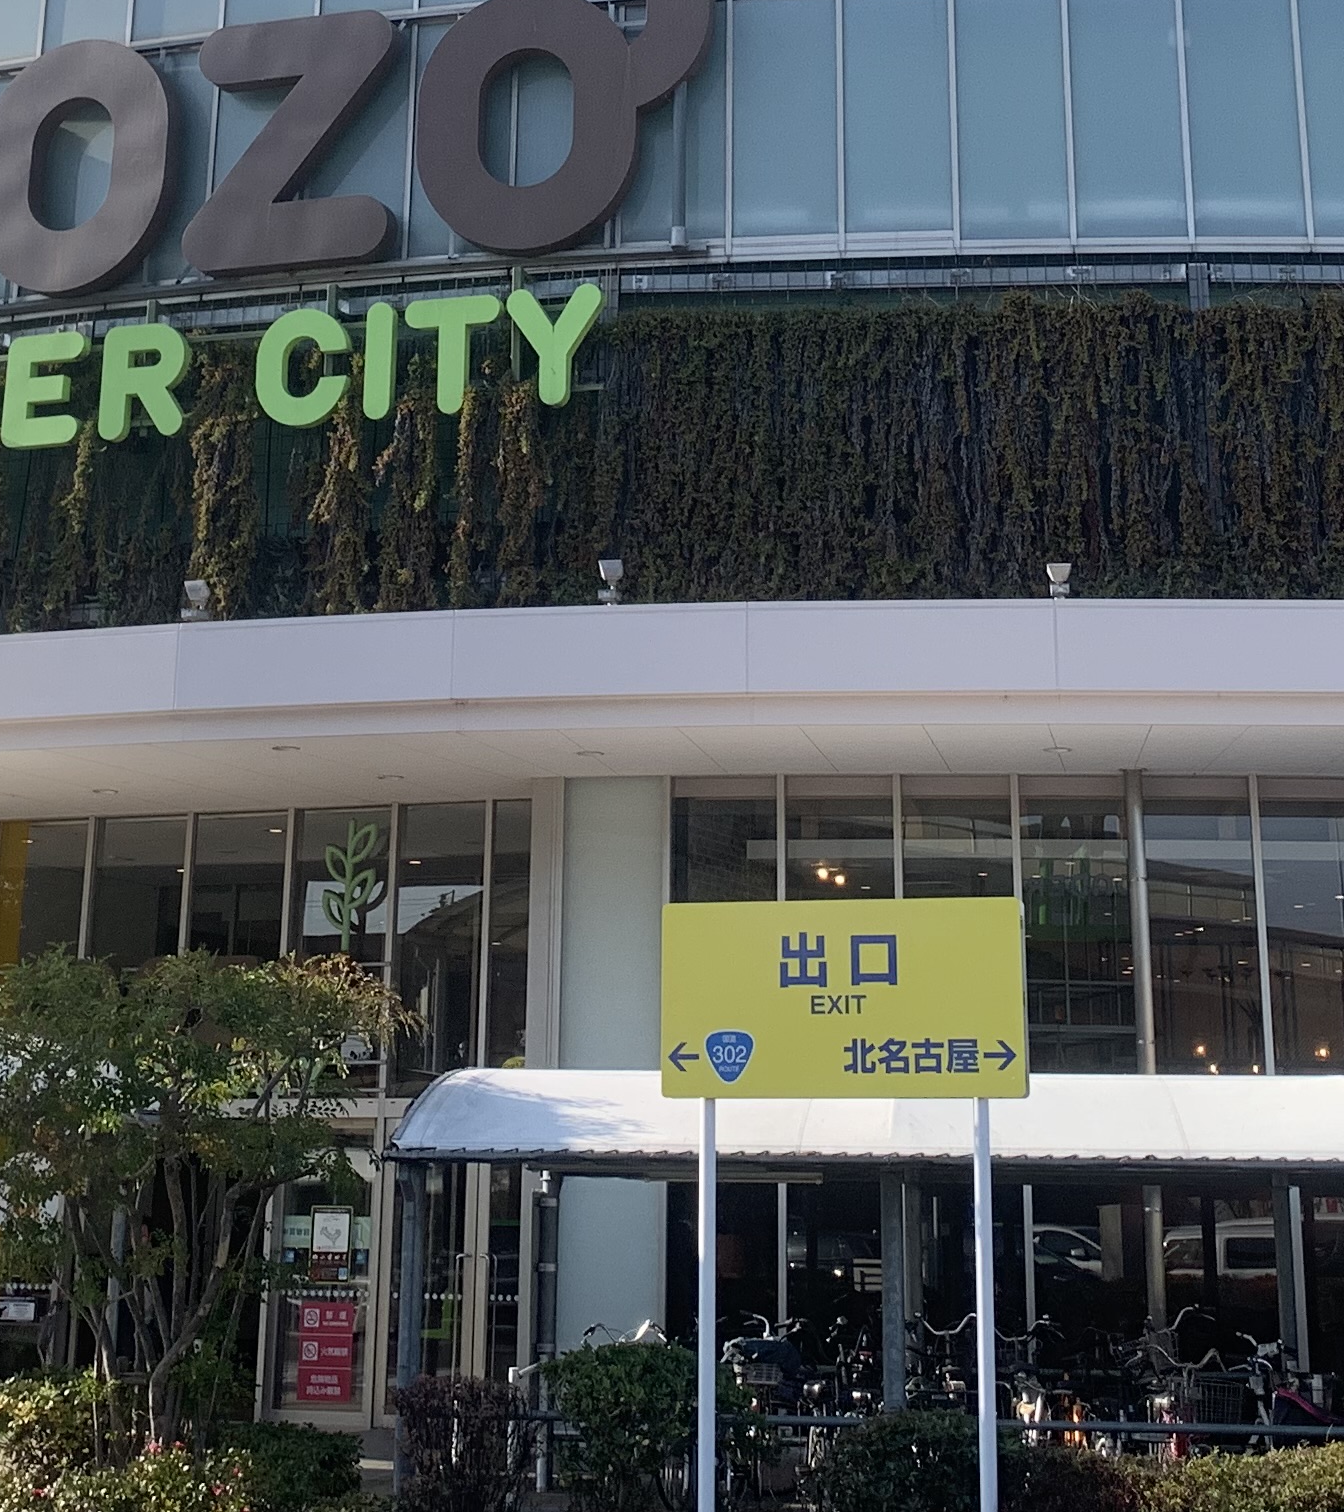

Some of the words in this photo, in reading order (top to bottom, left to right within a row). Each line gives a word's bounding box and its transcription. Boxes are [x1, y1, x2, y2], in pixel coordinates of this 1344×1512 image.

[255, 282, 605, 429] CITY
[779, 931, 898, 987] 出口
[810, 993, 868, 1015] EXIT
[712, 1045, 747, 1064] 302
[842, 1037, 981, 1075] 北名古屋
